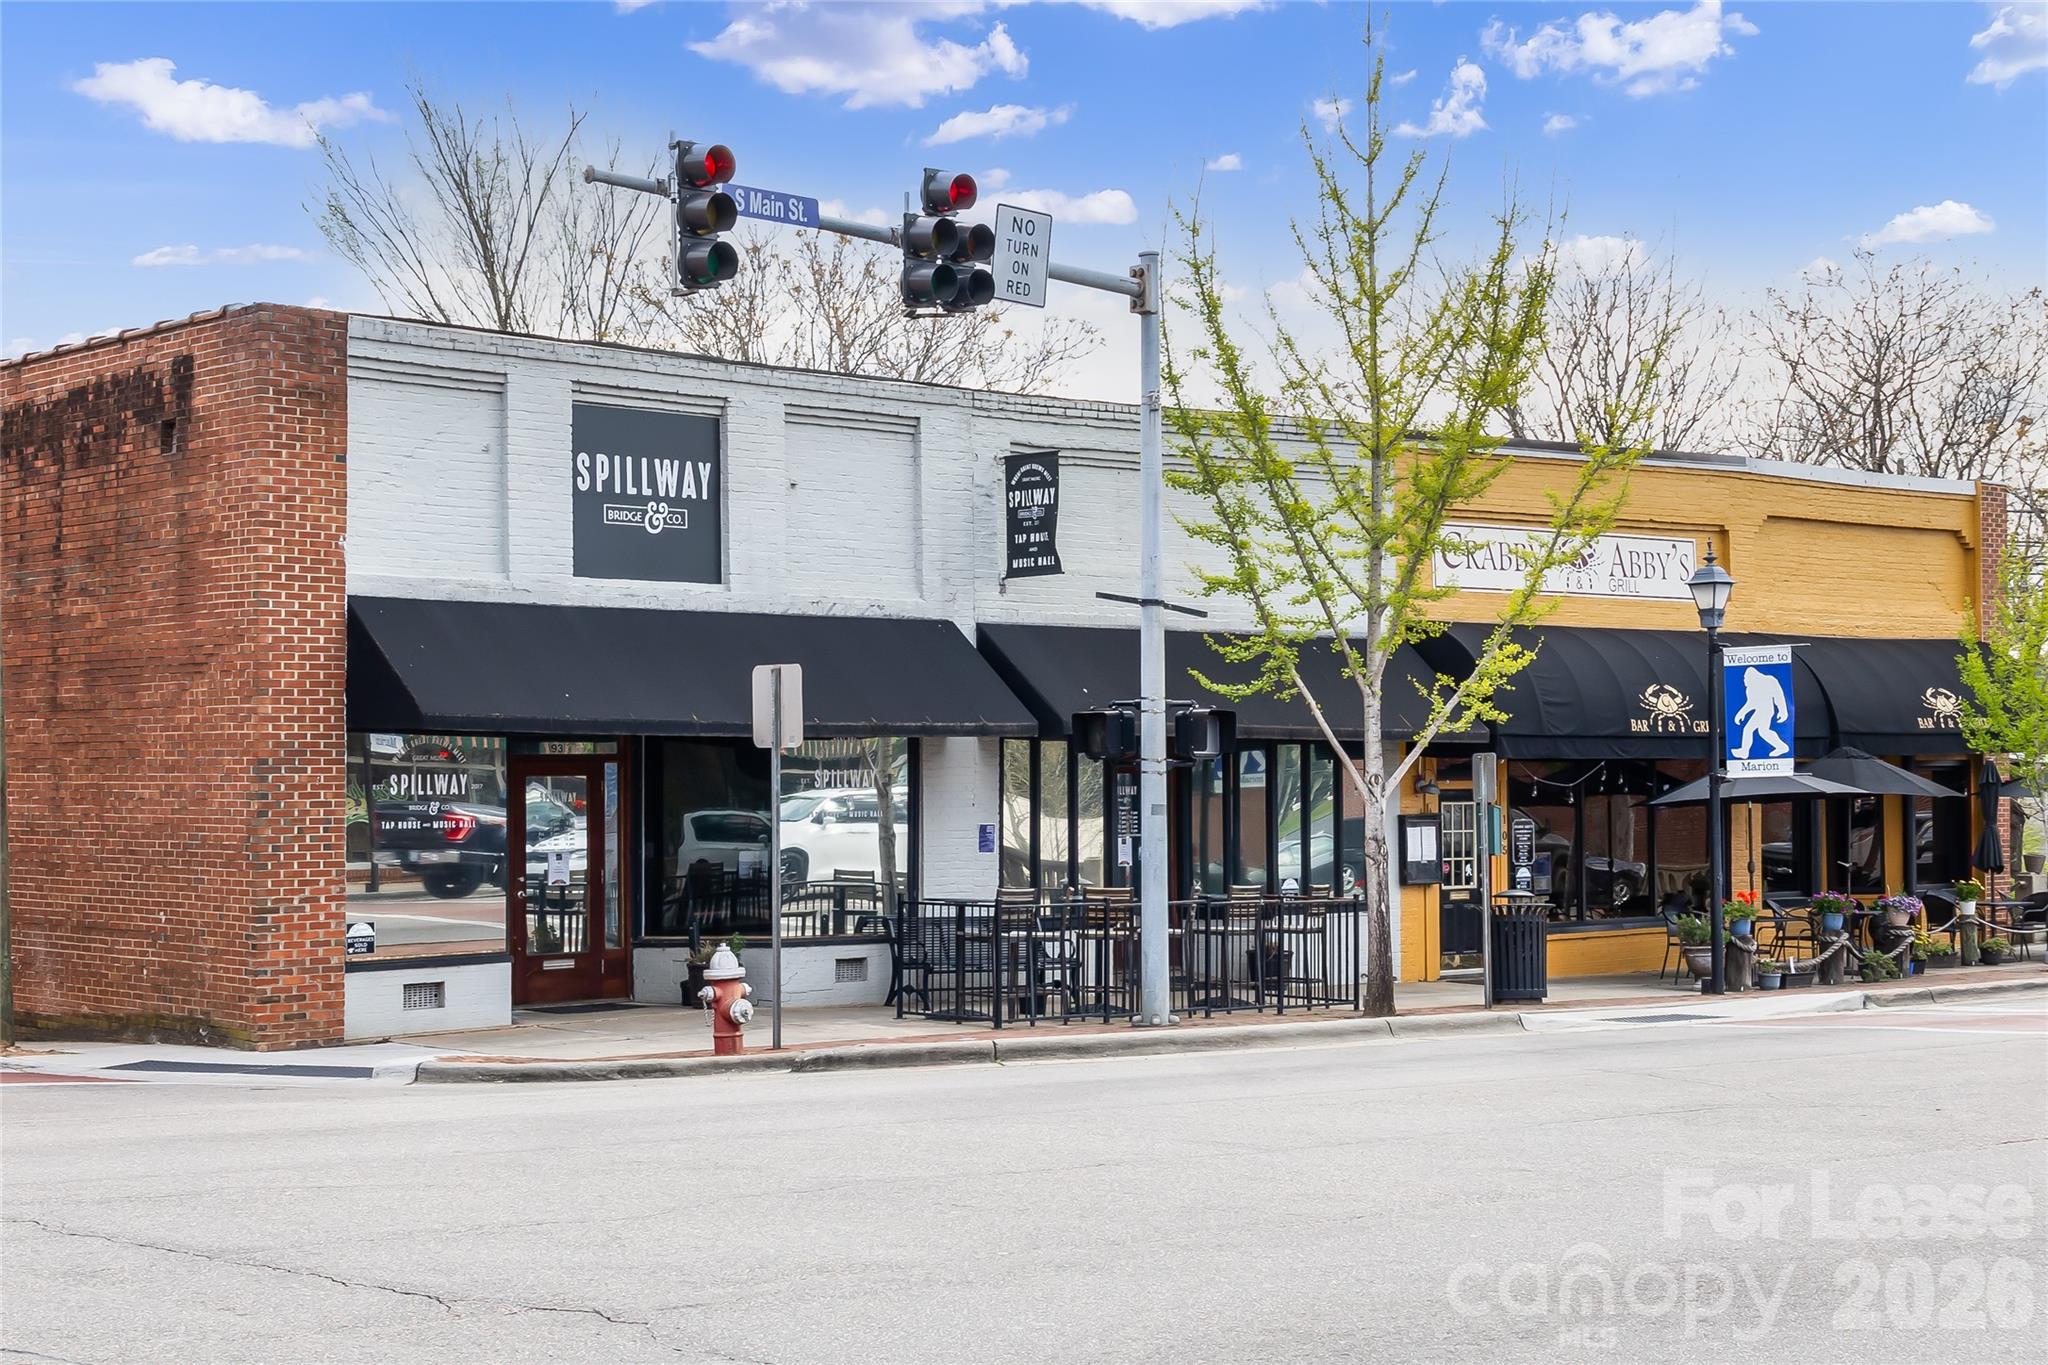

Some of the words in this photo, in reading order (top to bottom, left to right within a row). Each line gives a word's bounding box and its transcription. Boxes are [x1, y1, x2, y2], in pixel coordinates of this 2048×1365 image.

[734, 188, 746, 212] S
[749, 191, 785, 218] Main
[788, 198, 808, 222] St.
[1012, 216, 1035, 236] NO
[1006, 238, 1039, 258] TURN
[1012, 260, 1030, 276] ON
[1006, 279, 1031, 297] RED
[576, 452, 712, 500] SPILLWAY
[1008, 487, 1056, 508] SPILLWAY
[607, 509, 642, 522] BRIDGE
[644, 501, 669, 534] &
[666, 513, 684, 524] CO.
[1014, 533, 1027, 544] TAP
[1012, 557, 1035, 569] MUSIC
[1038, 555, 1055, 566] HALL
[1608, 542, 1690, 583] ABBY'S
[1576, 576, 1584, 590] &
[1608, 577, 1641, 594] GRILL
[1726, 653, 1775, 665] Welcome
[1777, 653, 1789, 662] to
[1630, 718, 1650, 732] BAR
[1668, 720, 1677, 732] &
[1693, 721, 1710, 733] GRI
[1917, 717, 1936, 729] BAR
[1948, 718, 1956, 729] &
[551, 743, 564, 753] 93
[1741, 761, 1780, 772] Marion
[390, 774, 467, 796] SPILLWAY
[814, 769, 876, 788] SPILLWAY
[429, 801, 440, 815] &
[849, 810, 868, 818] MUSIC
[381, 820, 395, 829] TAP
[398, 820, 422, 829] HOUSE
[433, 820, 457, 829] MUSIC
[459, 820, 476, 829] HALL
